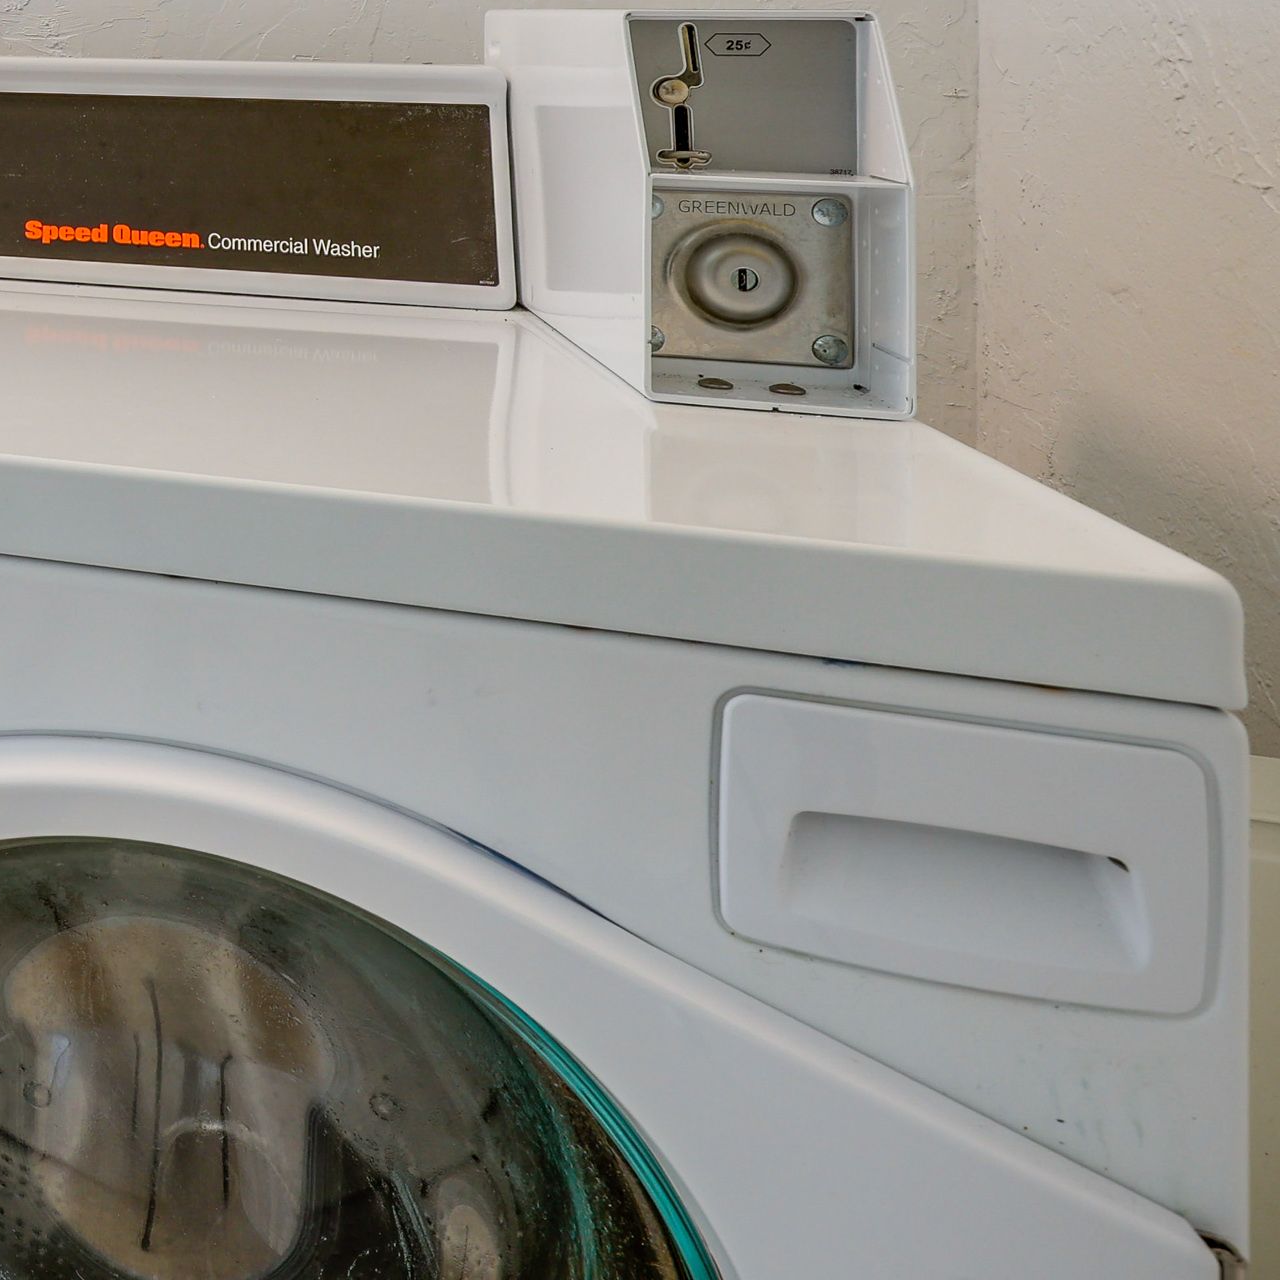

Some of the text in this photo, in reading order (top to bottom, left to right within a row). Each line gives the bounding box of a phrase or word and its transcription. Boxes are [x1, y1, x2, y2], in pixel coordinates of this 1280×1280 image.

[726, 40, 752, 50] 25¢
[678, 200, 796, 216] GREENWALD
[24, 220, 108, 244] Speed
[208, 233, 309, 254] Commercial
[312, 239, 380, 258] Washer
